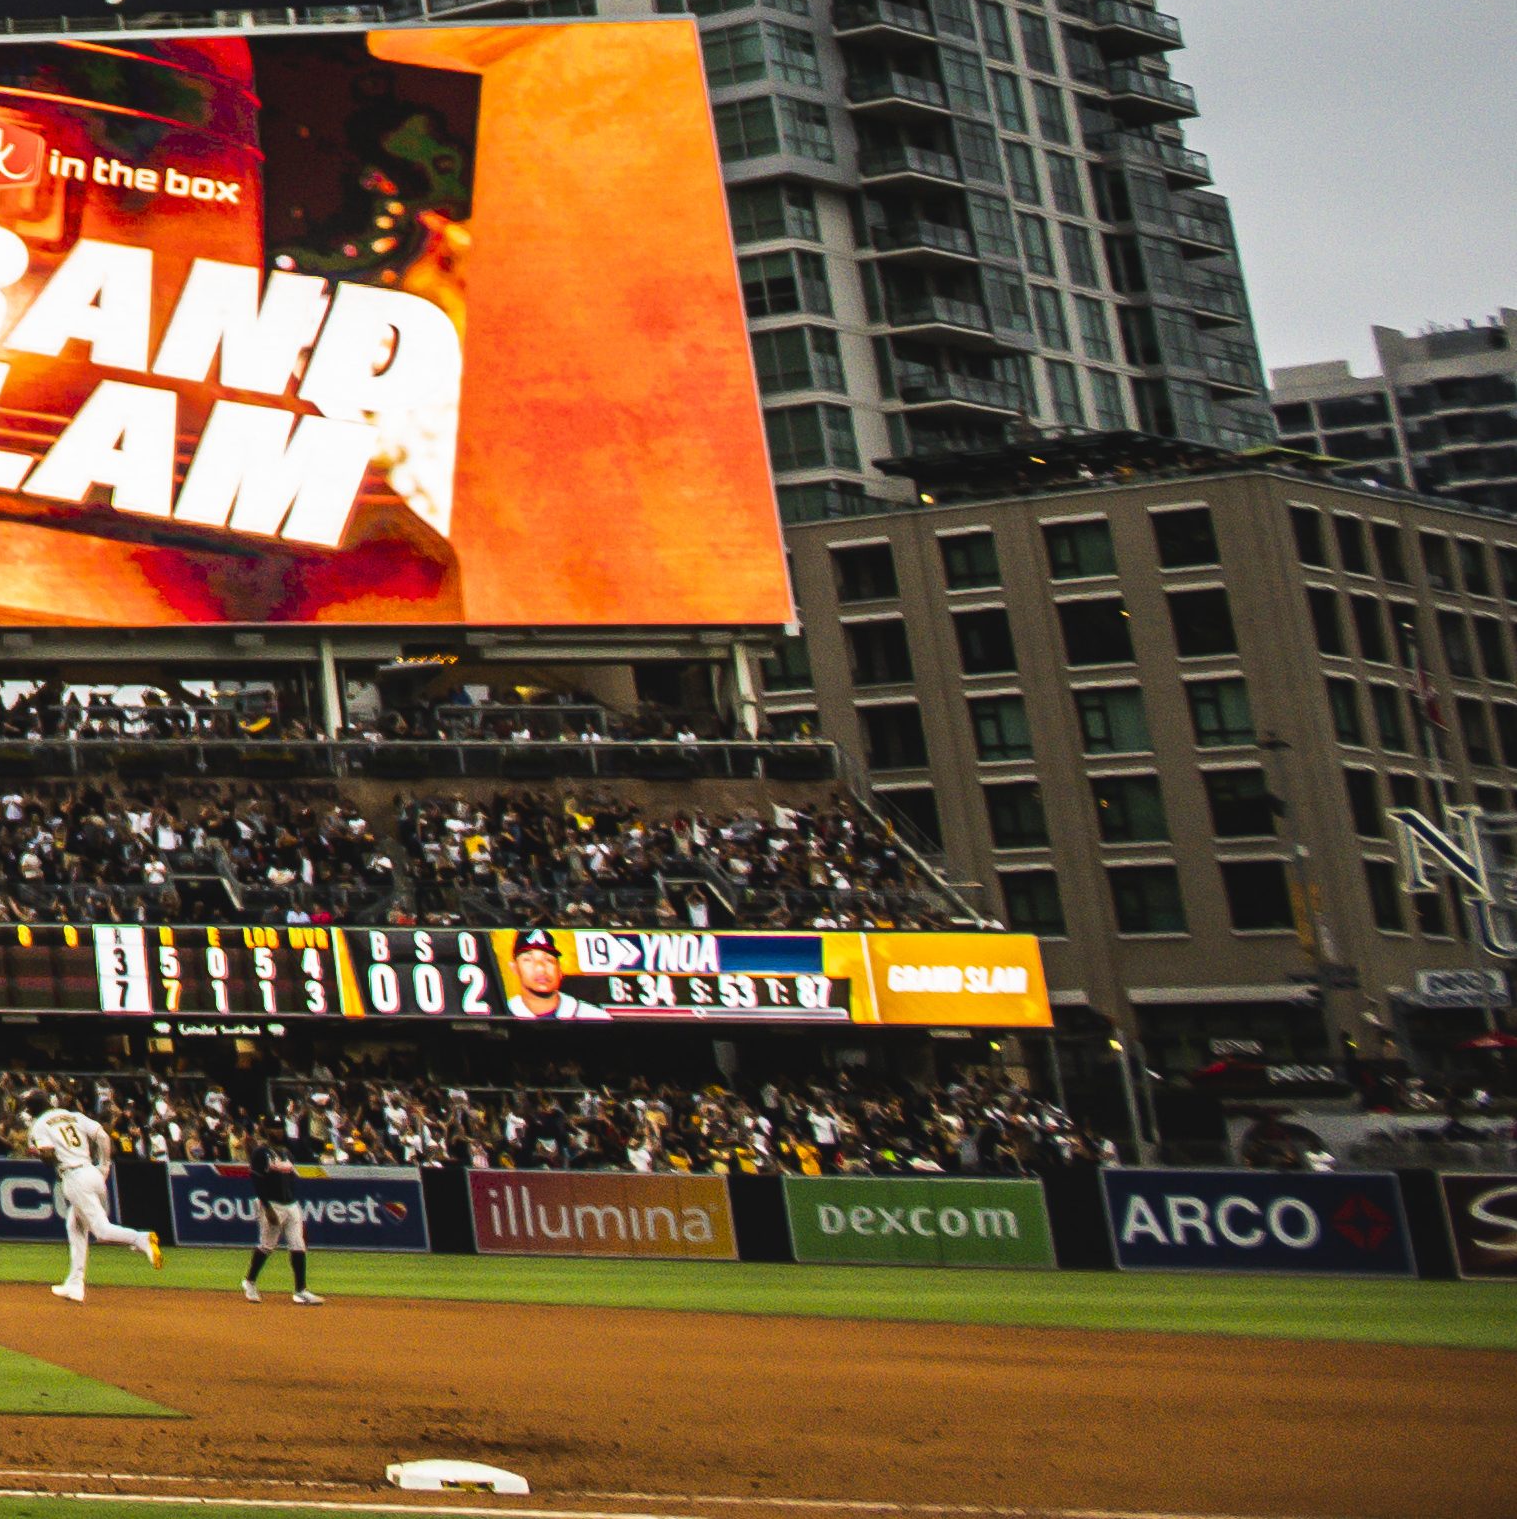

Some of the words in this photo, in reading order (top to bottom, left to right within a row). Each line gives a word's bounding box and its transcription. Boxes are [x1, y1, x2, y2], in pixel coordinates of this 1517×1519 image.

[48, 149, 86, 181] in
[93, 157, 158, 192] the
[165, 168, 240, 204] box
[113, 948, 127, 975] 3
[159, 946, 180, 978] 5
[206, 946, 228, 979] 0
[254, 947, 276, 980] 5
[301, 948, 323, 980] 4
[369, 930, 390, 962] B
[414, 930, 433, 962] S
[458, 931, 478, 963] O
[586, 937, 610, 966] 19
[640, 933, 718, 972] YNOA
[116, 980, 128, 1007] 7
[162, 979, 182, 1012] 7
[211, 980, 229, 1014] 1
[259, 980, 277, 1014] 1
[305, 980, 327, 1014] 3
[368, 963, 400, 1014] 0
[413, 963, 444, 1014] 0
[458, 963, 490, 1015] 2
[637, 976, 676, 1006] 34
[689, 978, 713, 1004] S:
[718, 976, 758, 1007] 53
[796, 976, 832, 1008] 87
[888, 965, 962, 993] GRAND
[965, 965, 1027, 994] SLAM
[59, 1125, 81, 1147] 13
[189, 1189, 382, 1224] Souwest
[488, 1184, 715, 1243] illumina
[1121, 1194, 1320, 1249] ARCO
